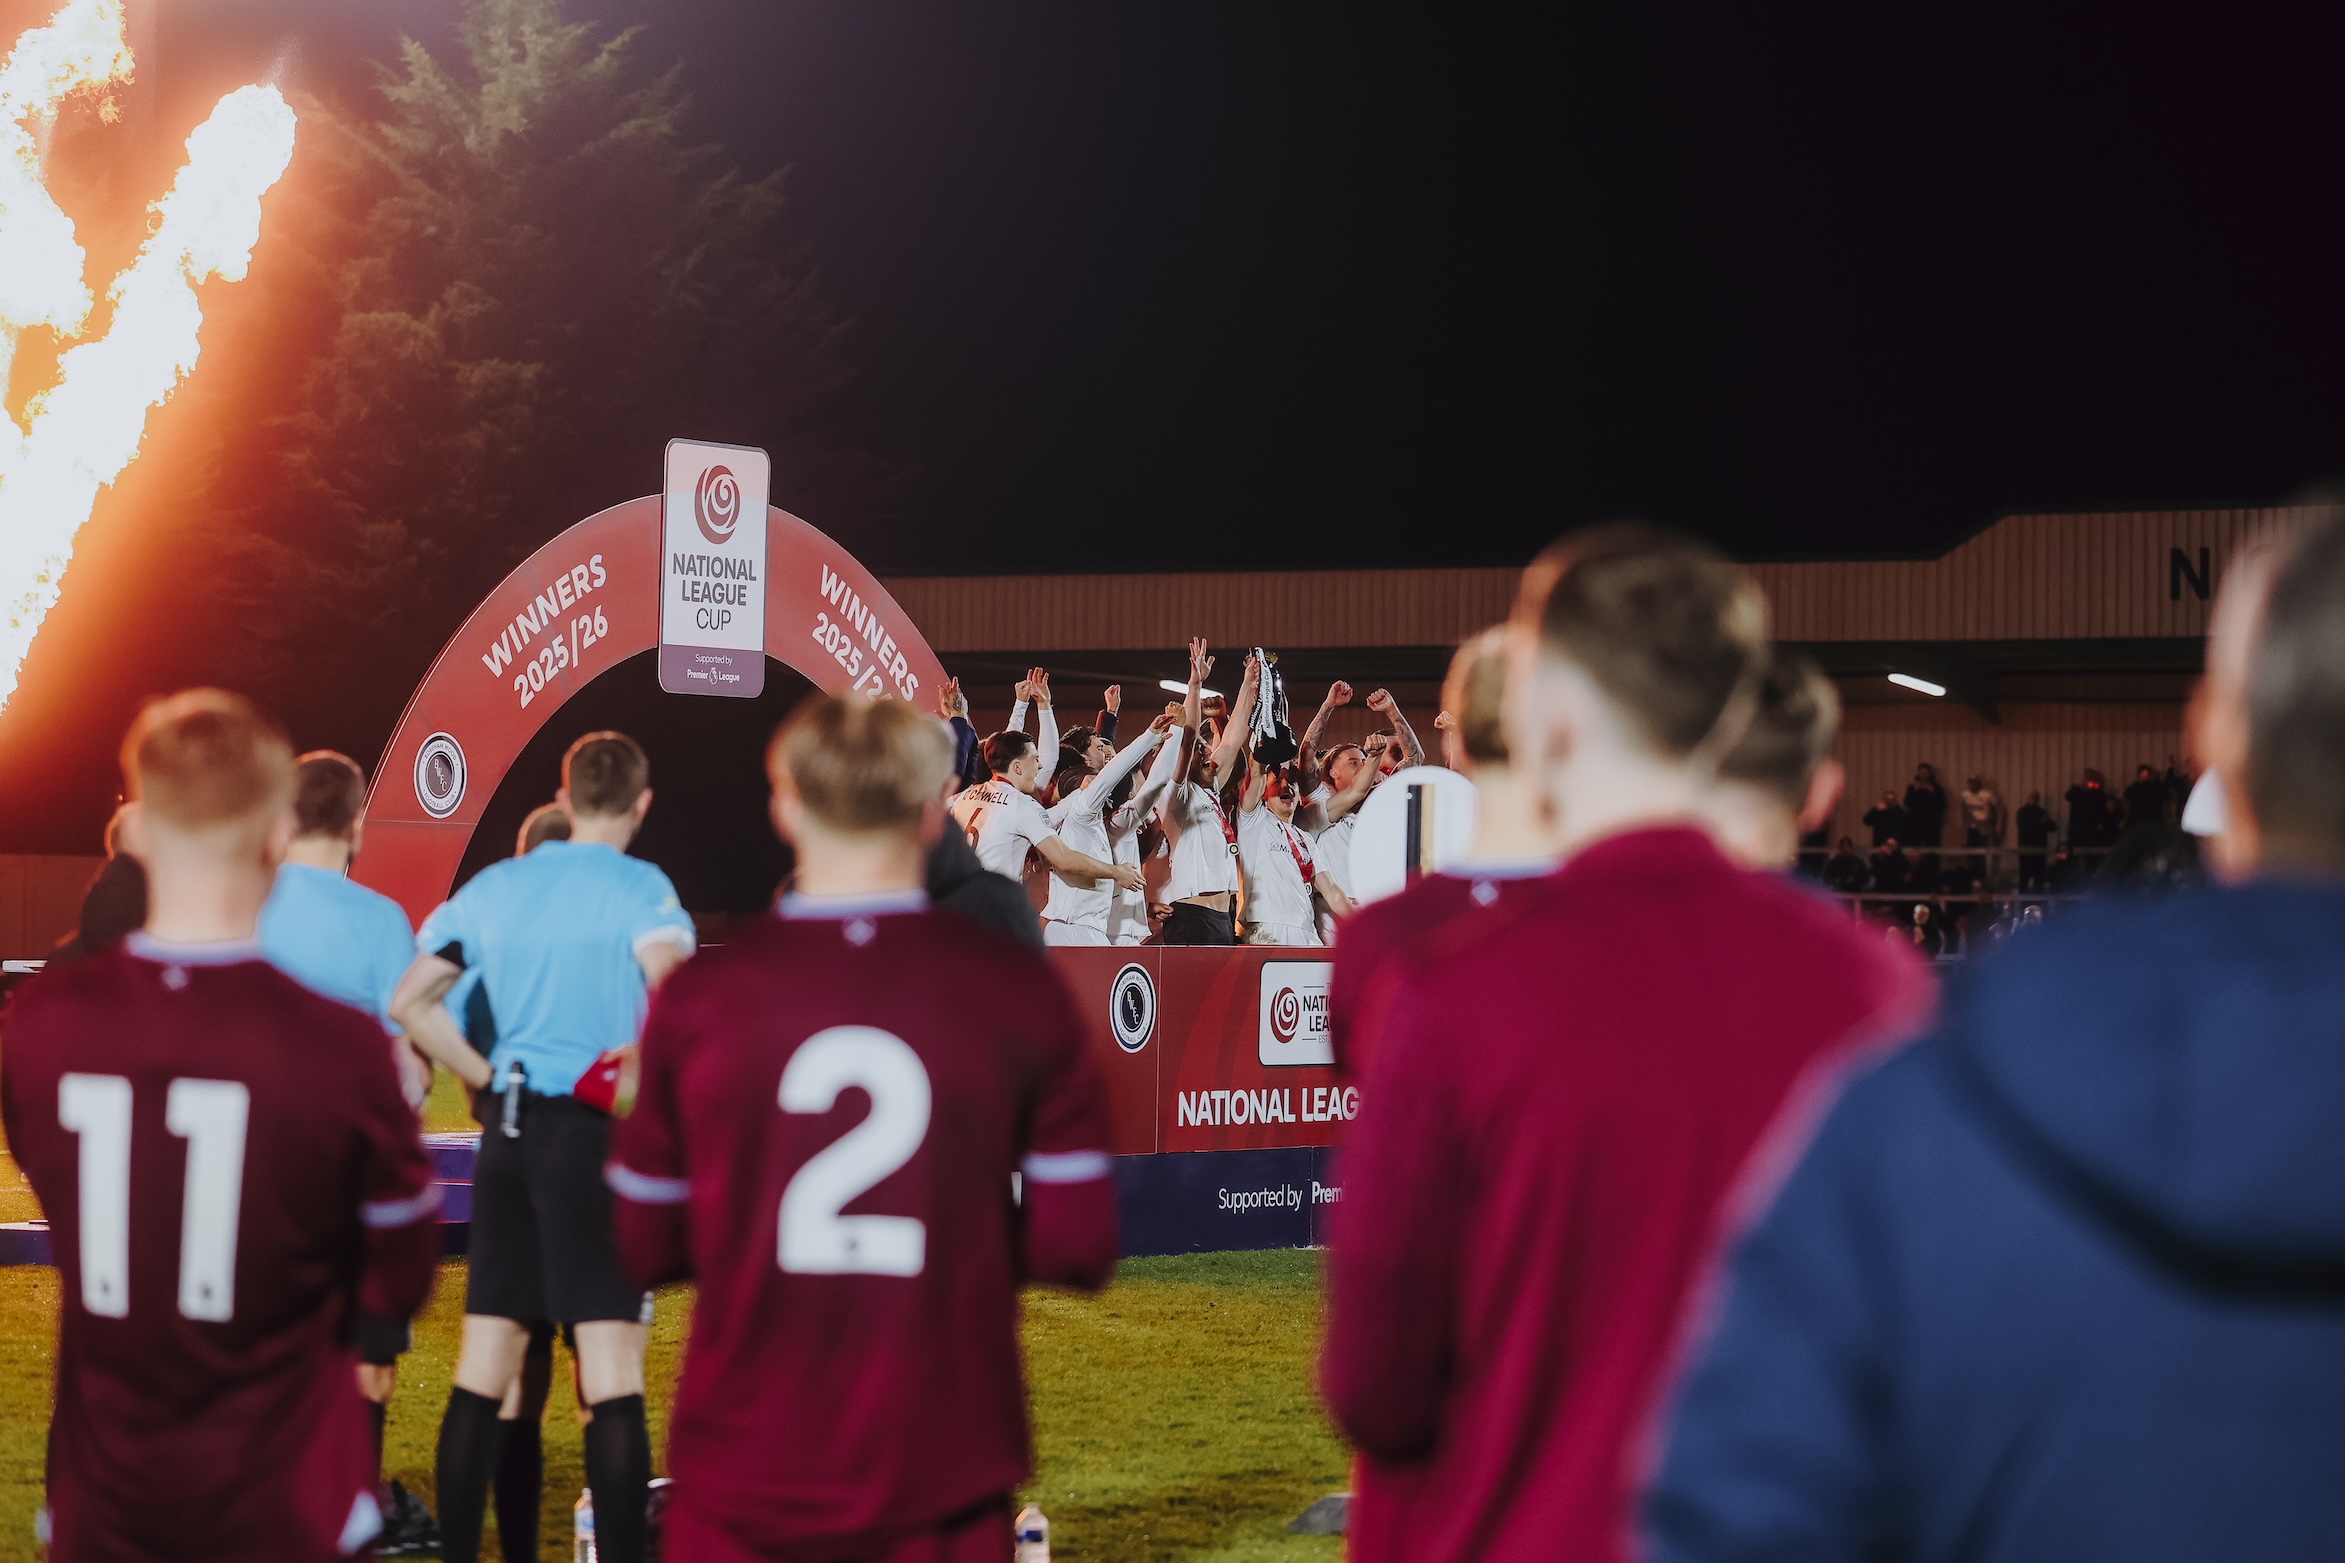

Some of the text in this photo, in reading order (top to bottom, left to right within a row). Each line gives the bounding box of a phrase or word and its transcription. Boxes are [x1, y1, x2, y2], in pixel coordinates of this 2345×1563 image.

[672, 552, 757, 581] NATIONAL
[2170, 546, 2210, 601] N
[681, 580, 747, 606] LEAGUE
[481, 553, 607, 678] WINNERS
[696, 608, 732, 631] CUP
[820, 563, 919, 702] WINNERS
[513, 604, 609, 710] 2025/26
[695, 653, 733, 666] Supported by
[812, 612, 894, 703] 2025/2
[687, 668, 741, 683] Premier League
[444, 744, 457, 761] WOOD
[1303, 995, 1331, 1012] NATI
[1177, 1088, 1297, 1127] NATIONAL
[777, 1024, 931, 1278] 2
[57, 1072, 250, 1324] 11
[1218, 1184, 1285, 1215] Supported
[1286, 1184, 1303, 1211] by
